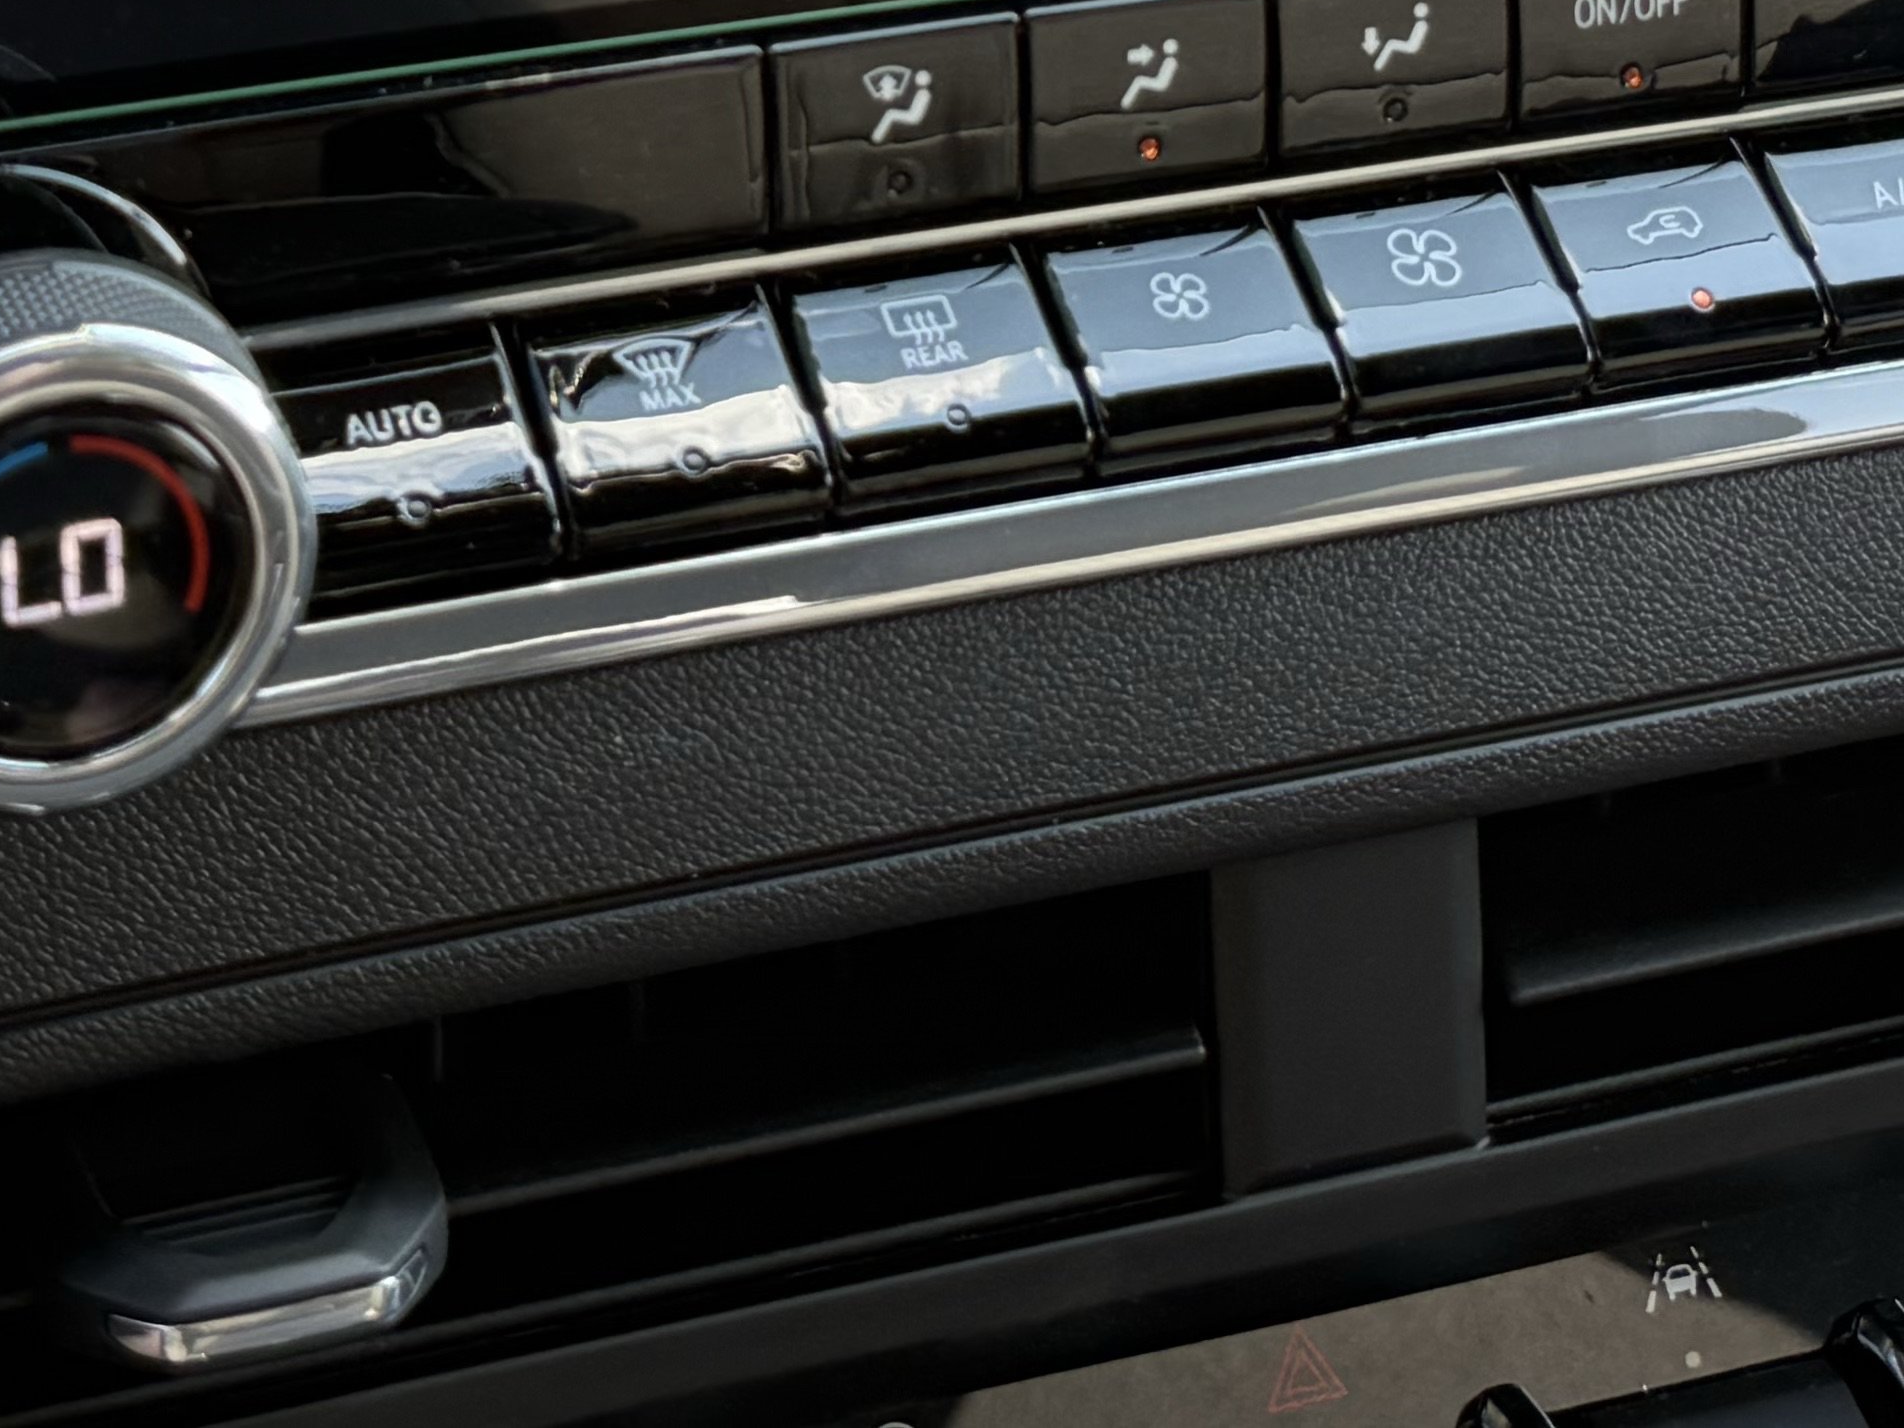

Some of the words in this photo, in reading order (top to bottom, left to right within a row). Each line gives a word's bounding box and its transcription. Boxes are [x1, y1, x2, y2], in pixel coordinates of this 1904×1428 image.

[900, 341, 968, 371] REAR
[639, 382, 702, 411] MAX
[345, 399, 443, 444] AUTO
